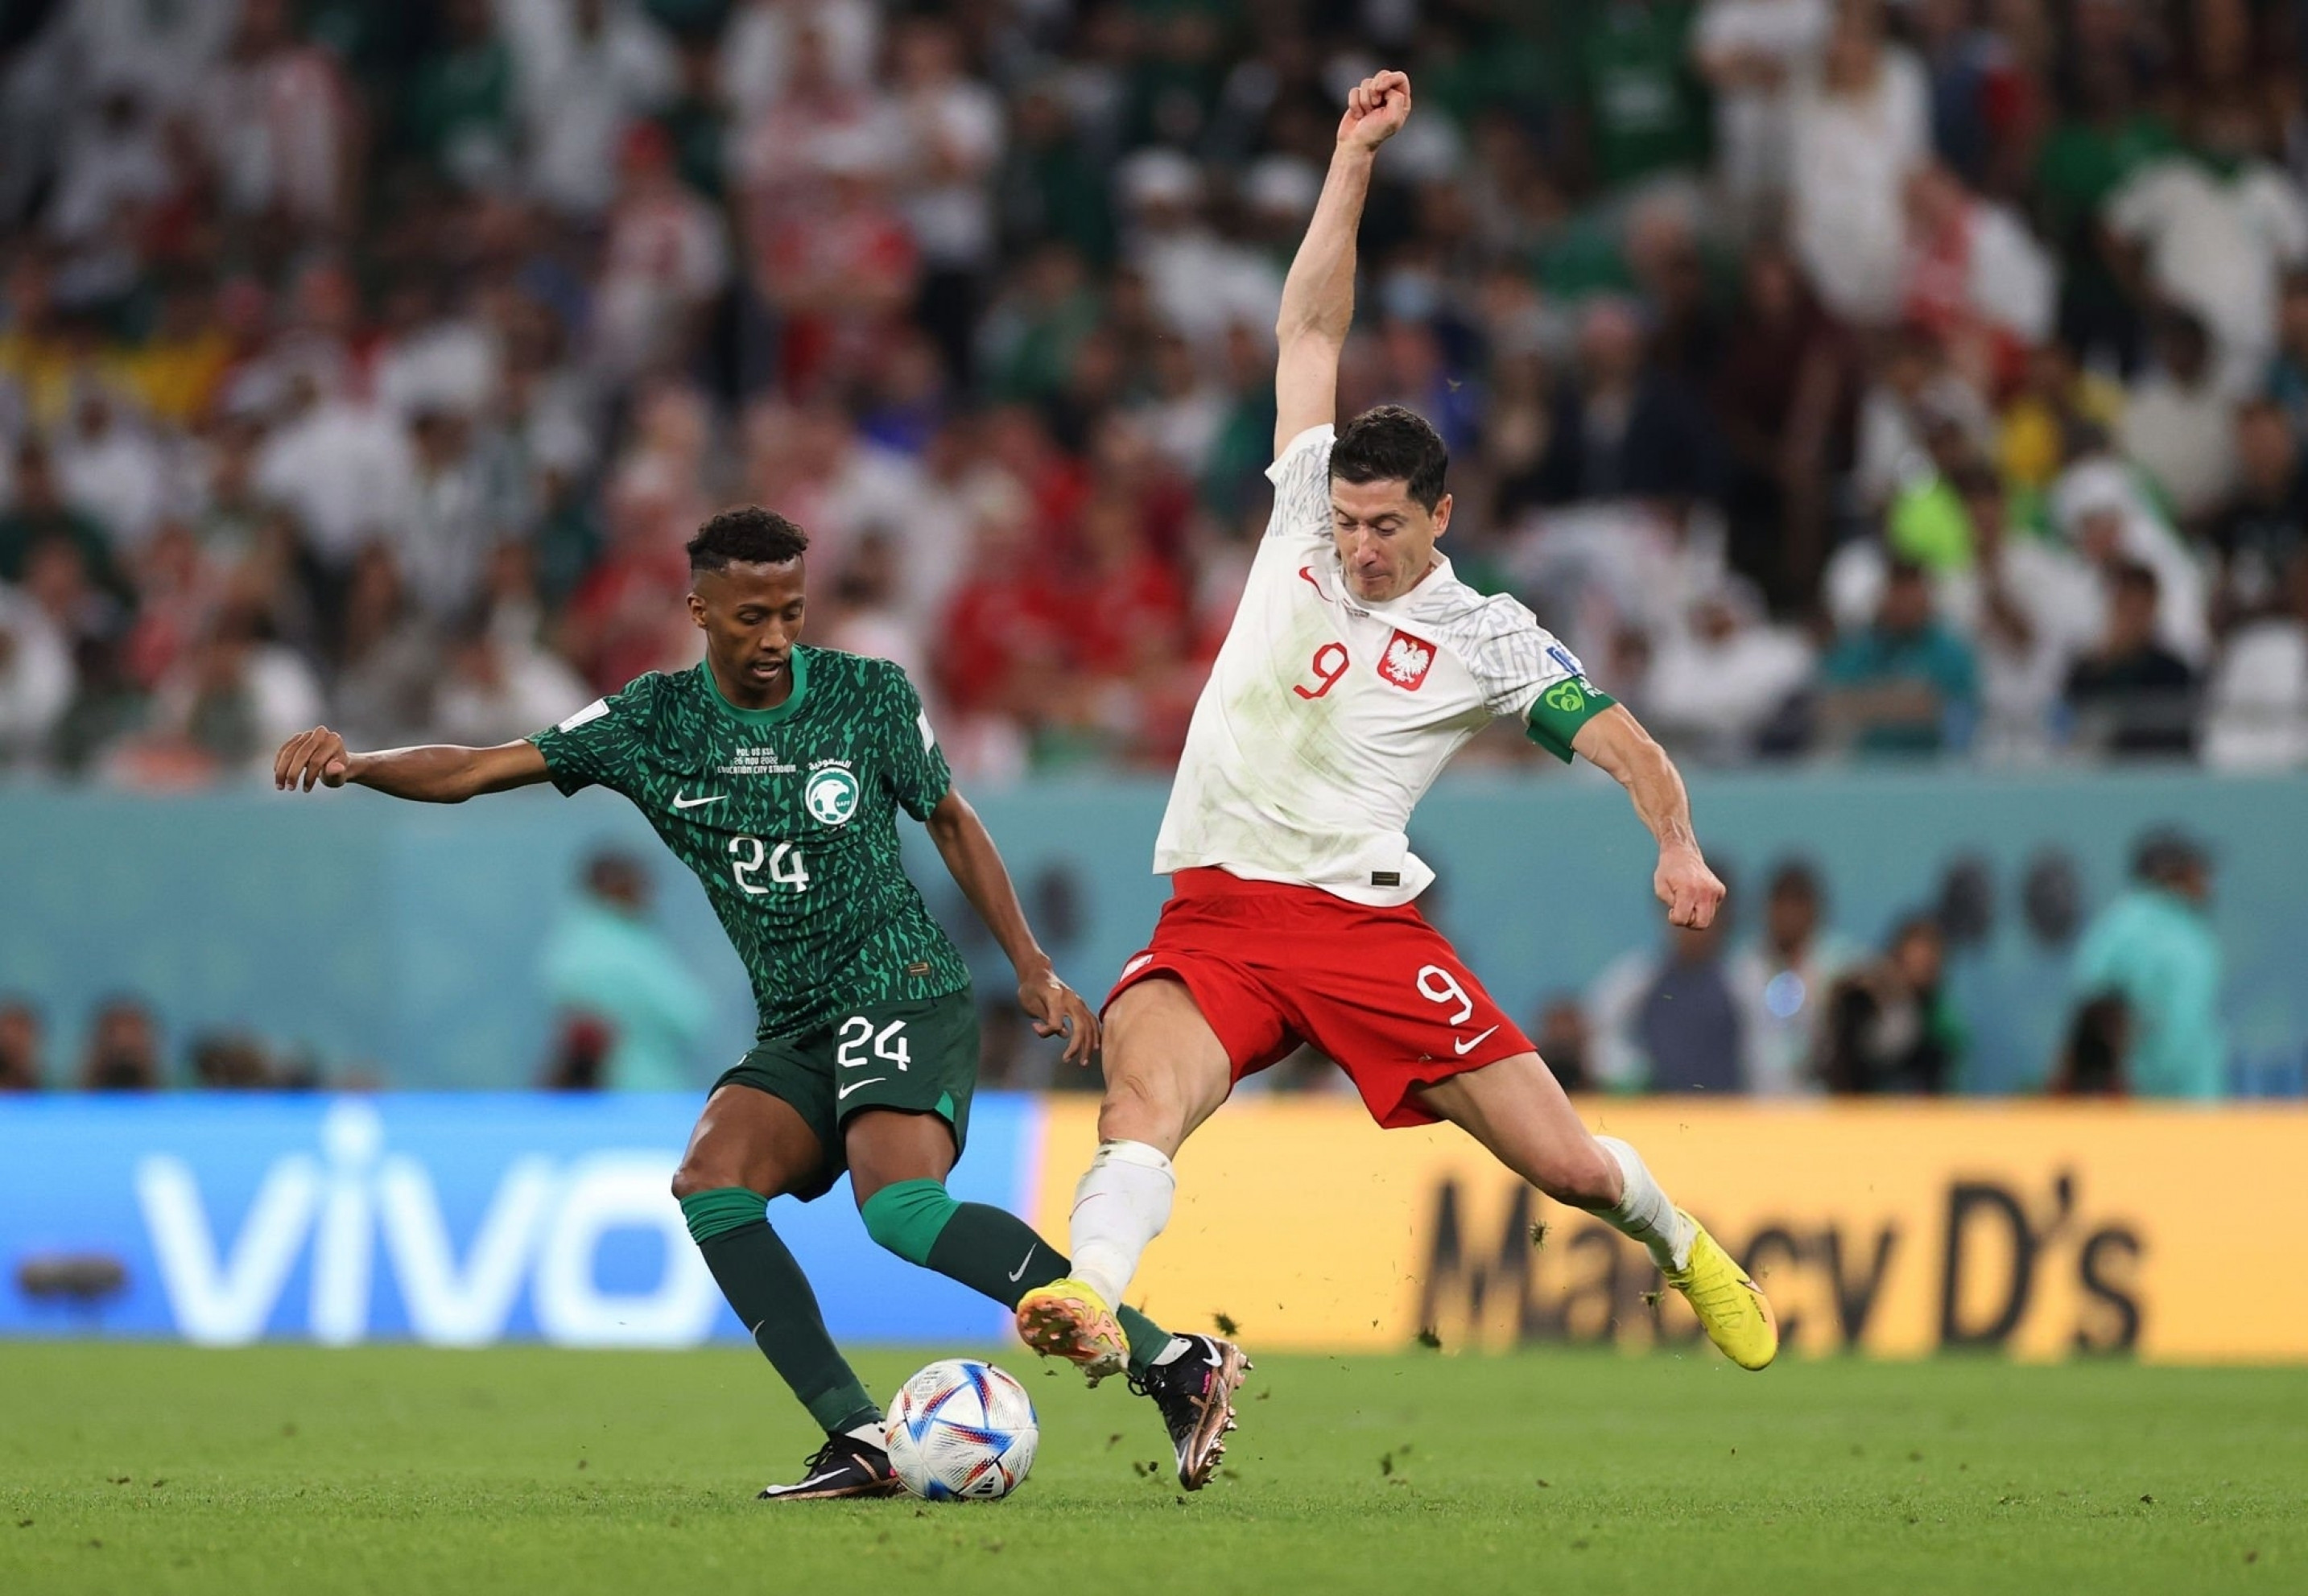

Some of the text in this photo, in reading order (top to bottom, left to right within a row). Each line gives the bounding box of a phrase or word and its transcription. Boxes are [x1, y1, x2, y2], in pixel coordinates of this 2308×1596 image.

[1293, 641, 1350, 700] 9
[736, 748, 749, 756] POL
[729, 834, 810, 893] 24
[1417, 964, 1473, 1026] 9
[838, 1016, 911, 1072] 24
[135, 1101, 726, 1347] vivo
[1938, 1171, 2145, 1360] D's
